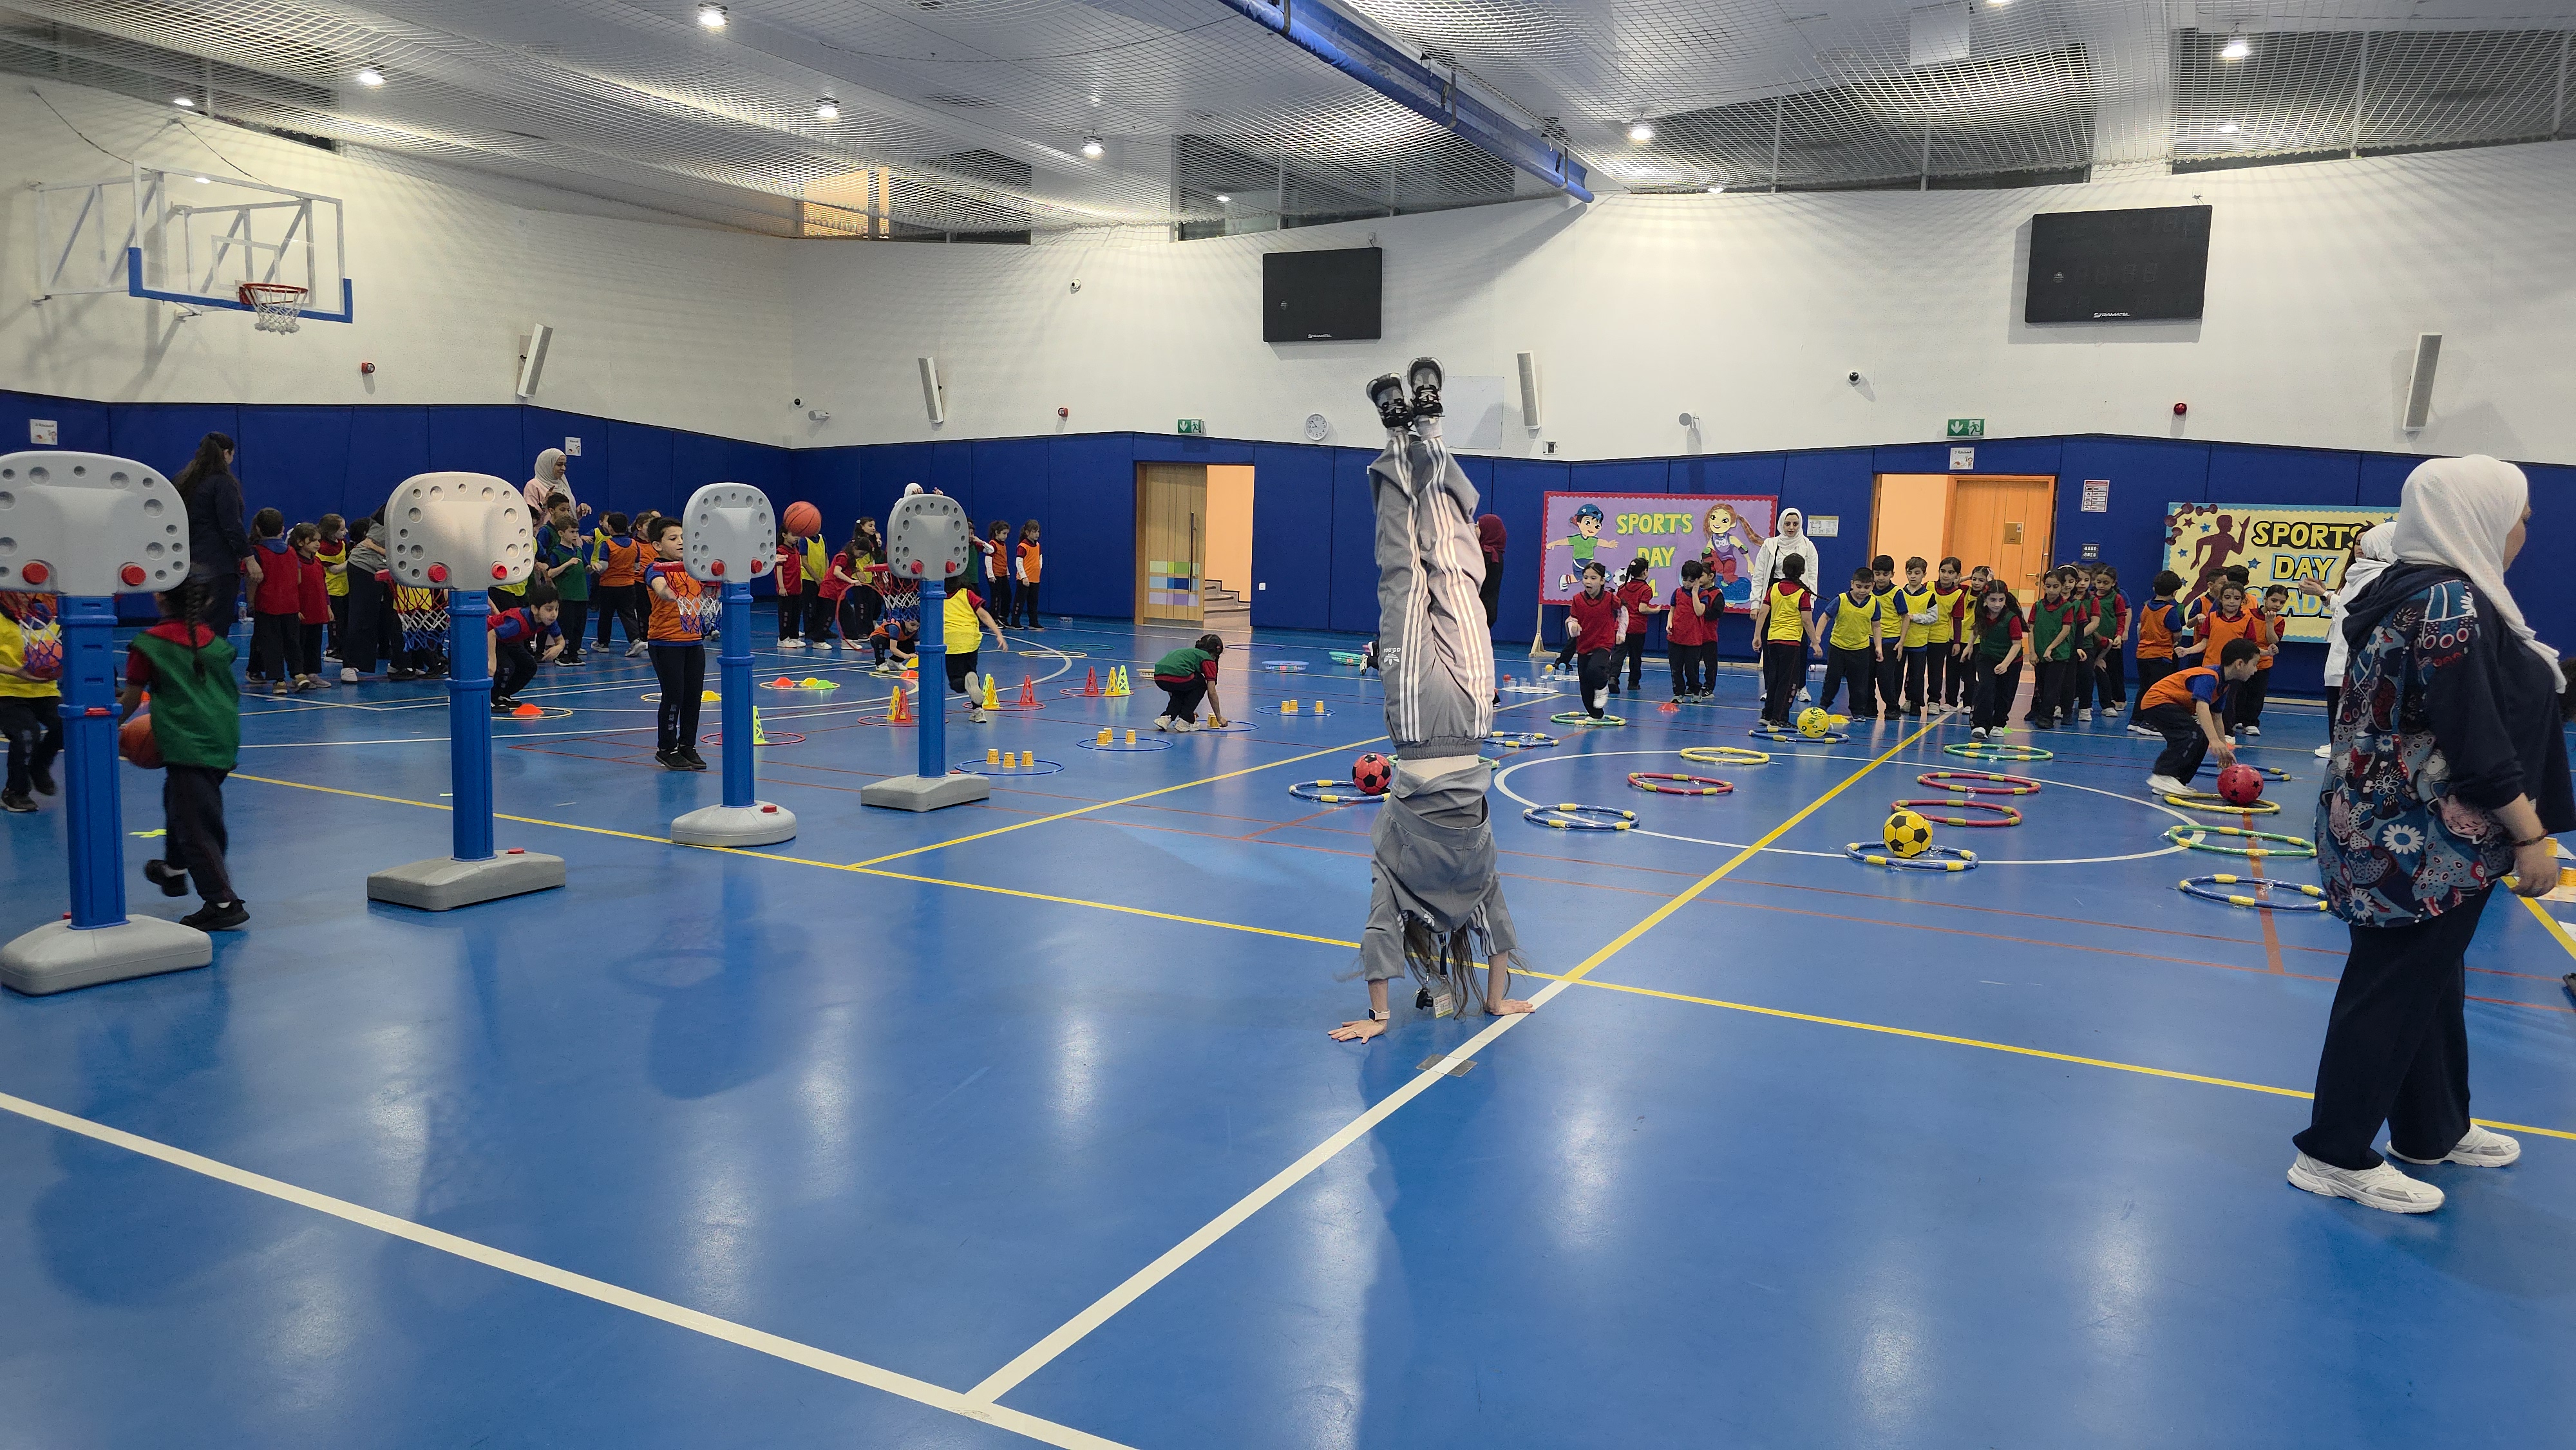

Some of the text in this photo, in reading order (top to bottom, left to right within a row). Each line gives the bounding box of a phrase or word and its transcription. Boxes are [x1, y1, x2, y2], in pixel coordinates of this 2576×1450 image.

[1616, 513, 1693, 534] SPORTS
[1638, 547, 1676, 567] DAY
[2274, 556, 2335, 581] DAY
